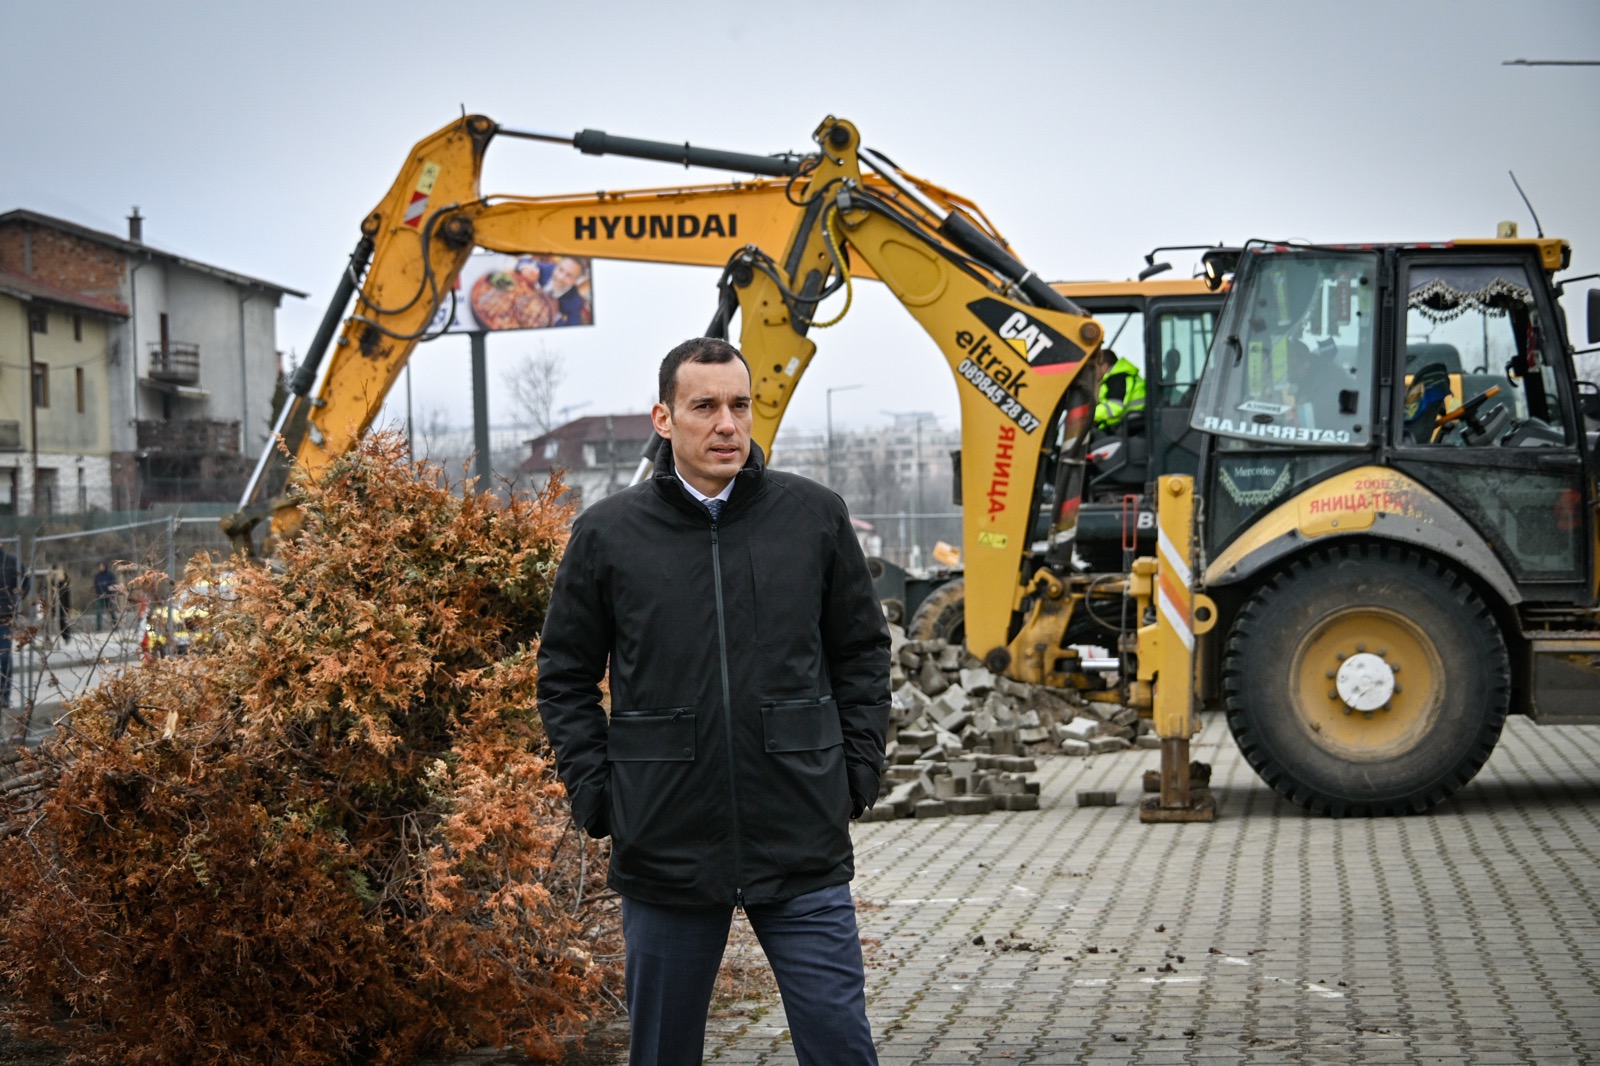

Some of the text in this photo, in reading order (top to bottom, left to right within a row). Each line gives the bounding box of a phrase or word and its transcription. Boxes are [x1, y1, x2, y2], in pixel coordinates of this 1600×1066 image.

[574, 214, 737, 240] HYUNDAI
[999, 311, 1053, 363] CAT
[956, 330, 1028, 397] eltrak
[1001, 399, 1019, 419] 28
[1017, 411, 1040, 433] 97
[1234, 466, 1276, 478] Mercedes
